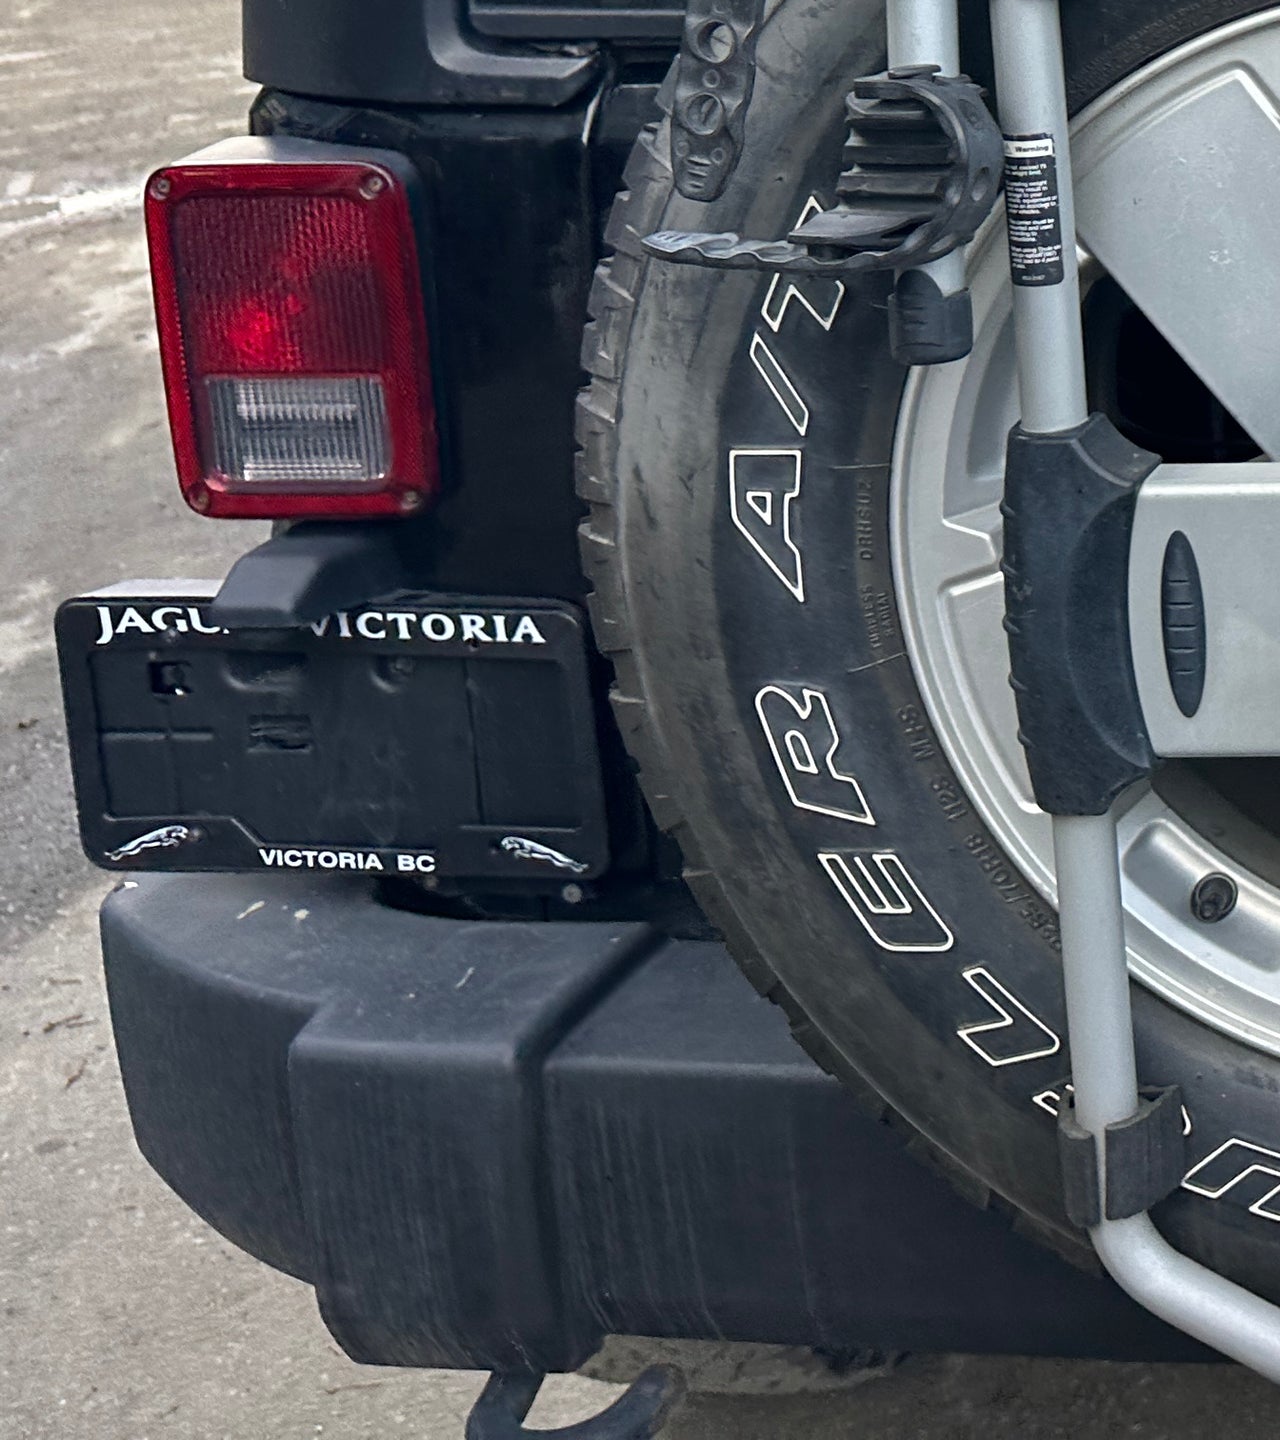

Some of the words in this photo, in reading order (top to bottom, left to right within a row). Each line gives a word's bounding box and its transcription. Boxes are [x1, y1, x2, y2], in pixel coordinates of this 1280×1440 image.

[96, 606, 230, 645] JAGU
[309, 611, 547, 644] VICTORIA
[258, 848, 384, 871] VICTORIA
[397, 854, 436, 872] BC
